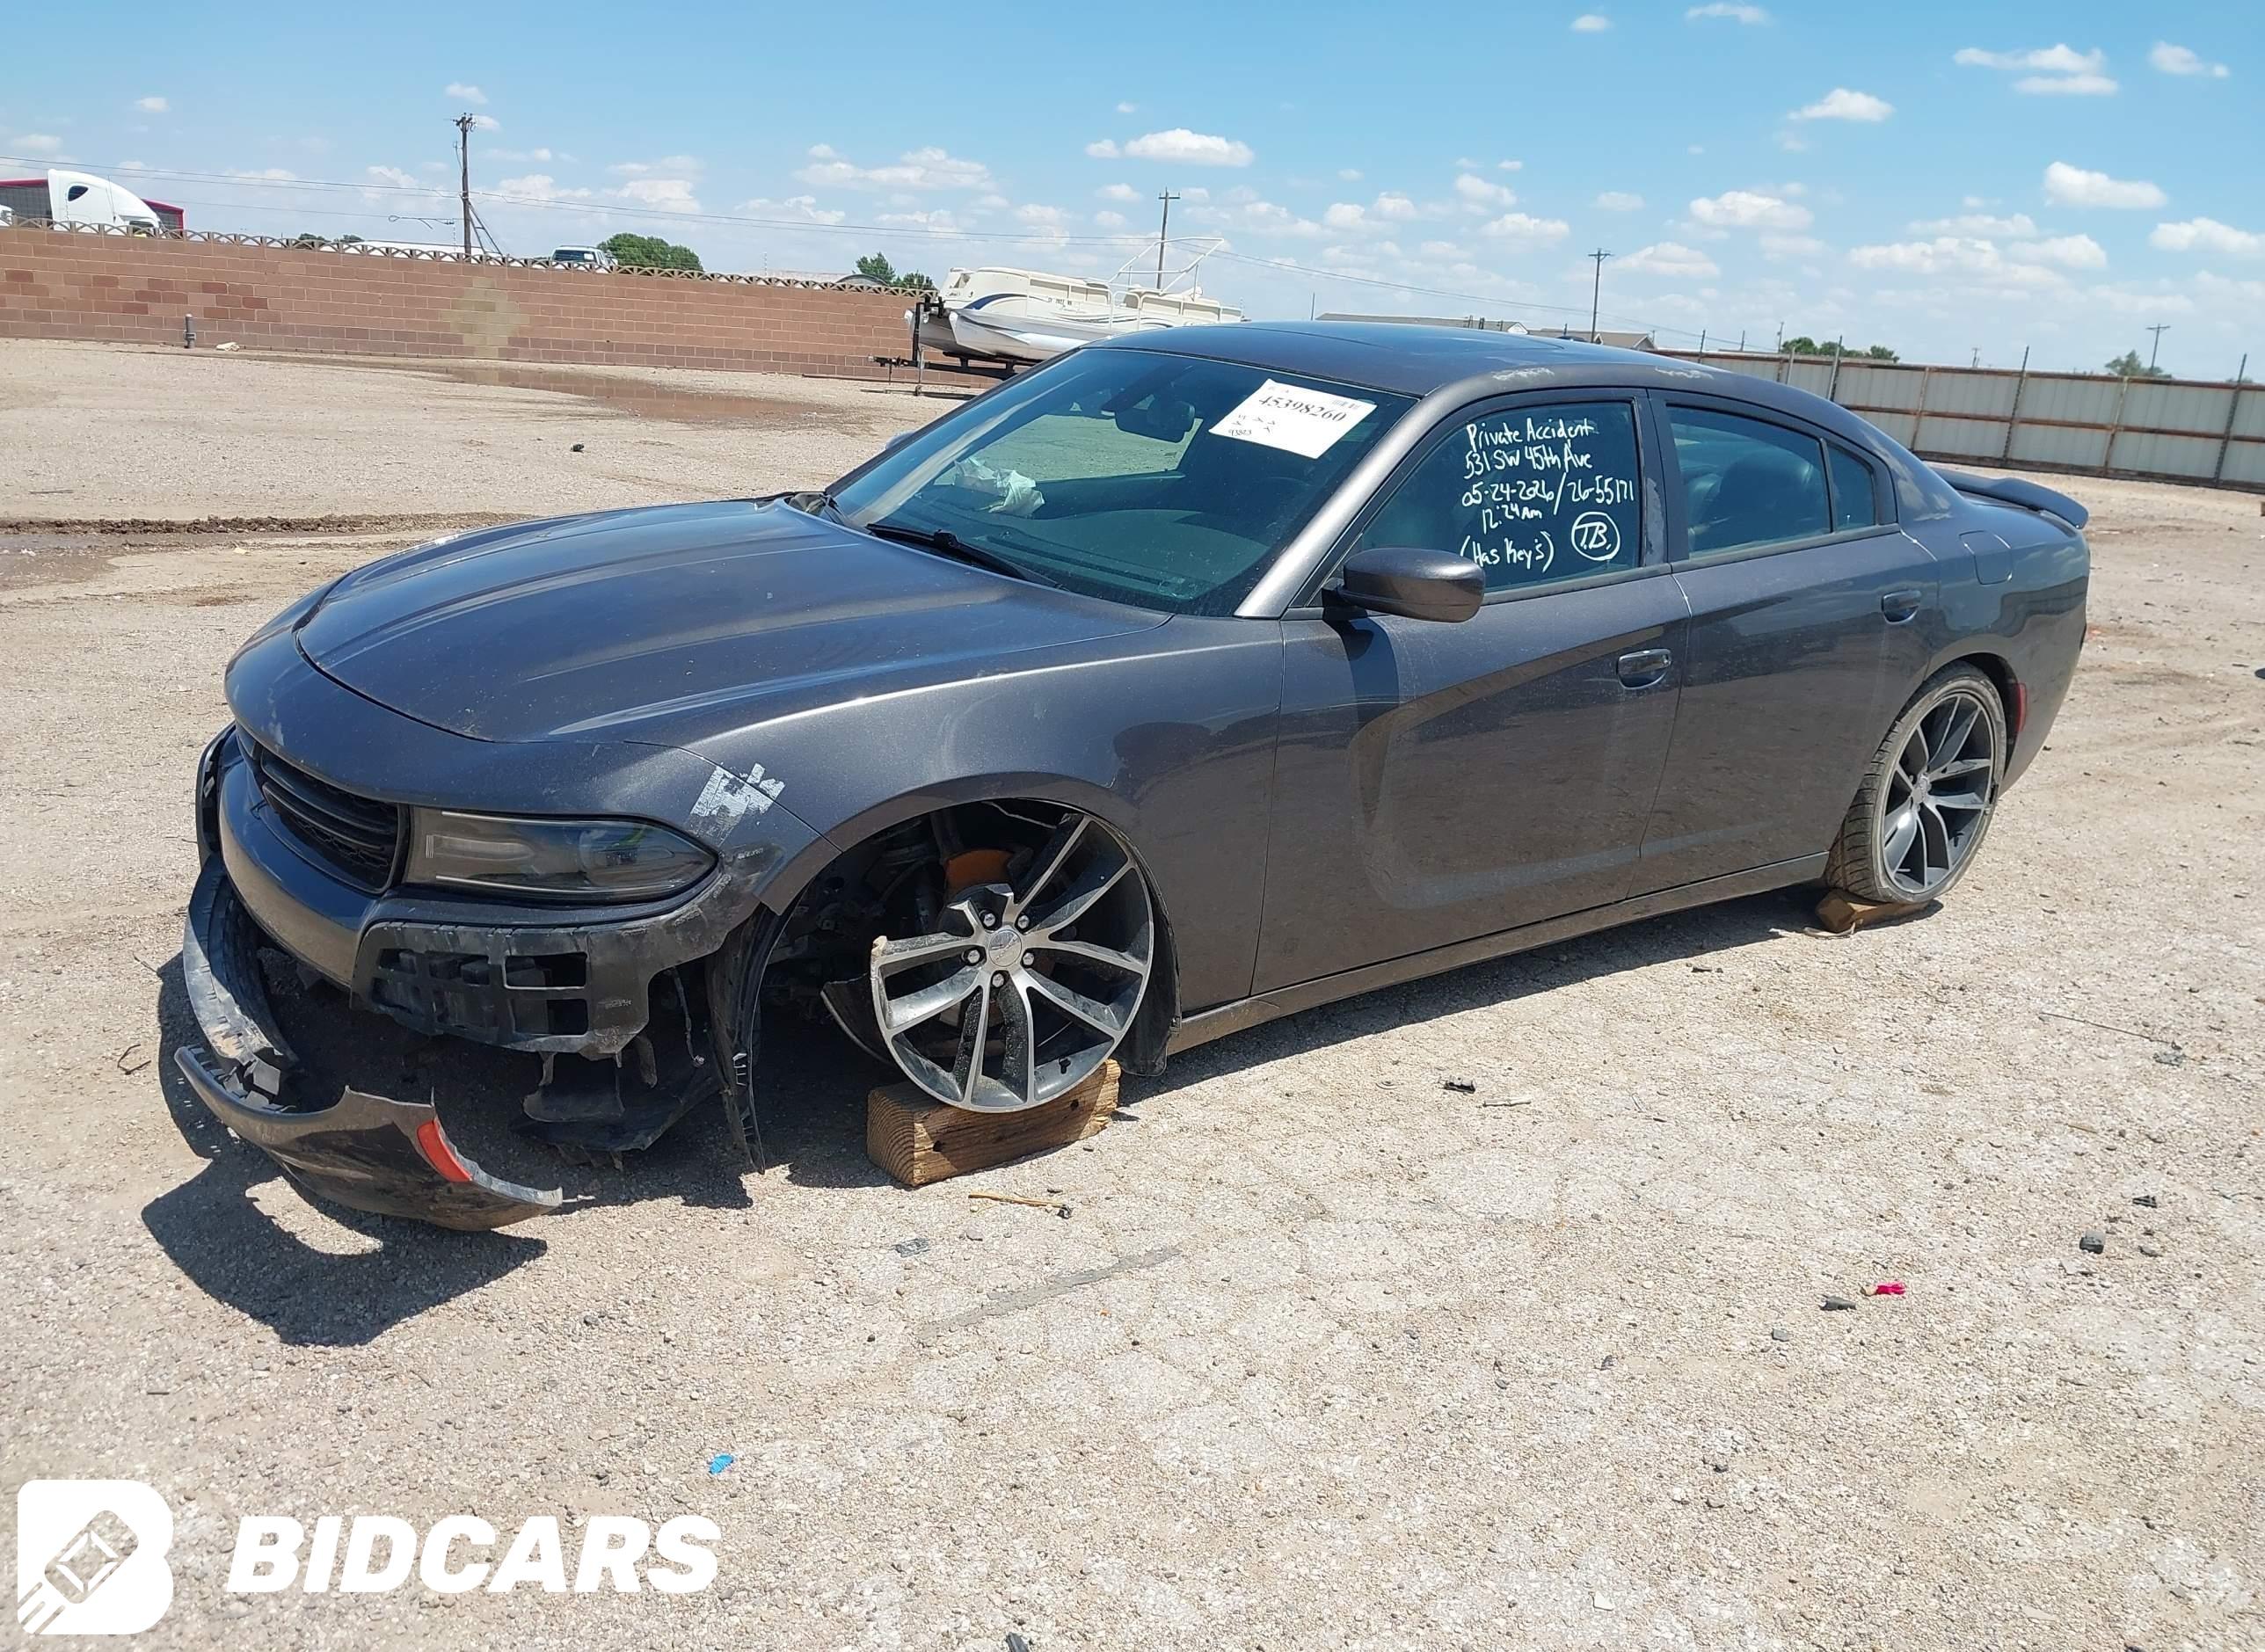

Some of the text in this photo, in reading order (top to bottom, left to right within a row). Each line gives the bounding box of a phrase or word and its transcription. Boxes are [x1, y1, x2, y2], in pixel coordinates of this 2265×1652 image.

[1258, 396, 1348, 422] 45398260
[1466, 417, 1596, 451] Private Accident
[1464, 441, 1593, 479] 531 SW 45th Ave
